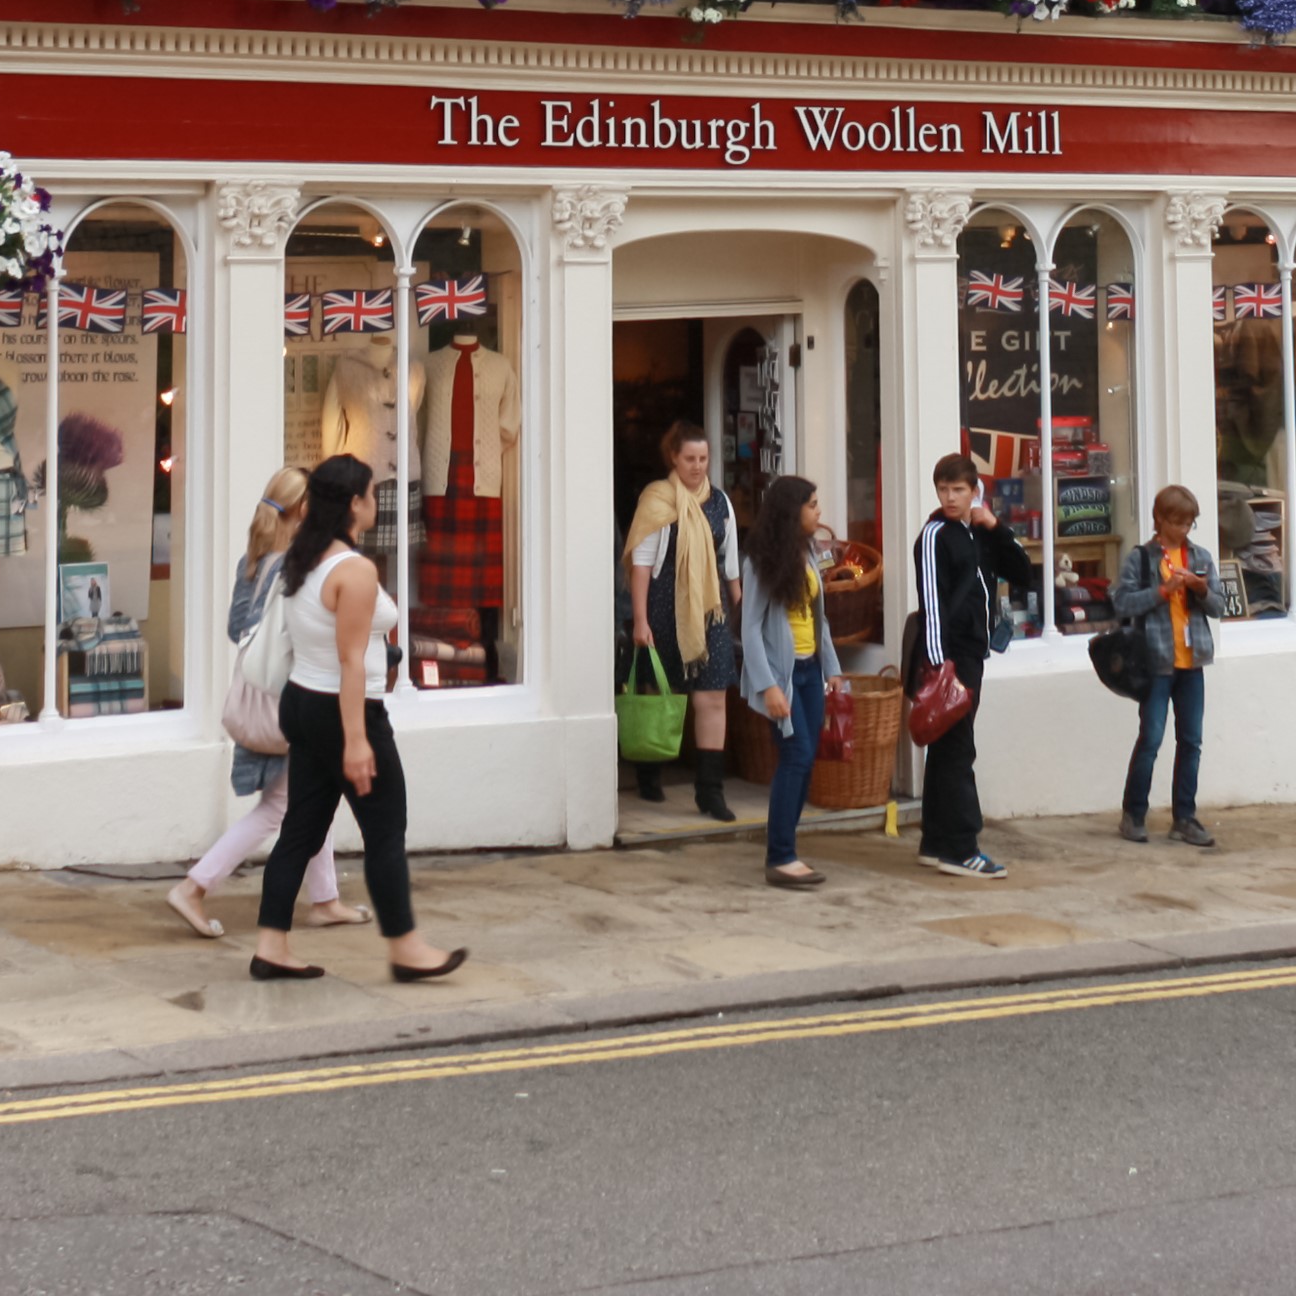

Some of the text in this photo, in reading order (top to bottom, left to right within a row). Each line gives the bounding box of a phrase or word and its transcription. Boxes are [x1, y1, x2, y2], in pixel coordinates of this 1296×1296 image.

[430, 95, 1063, 165] The Edinburgh Woollen Mill
[81, 333, 98, 344] the
[92, 369, 109, 381] the
[112, 371, 139, 382] rose.
